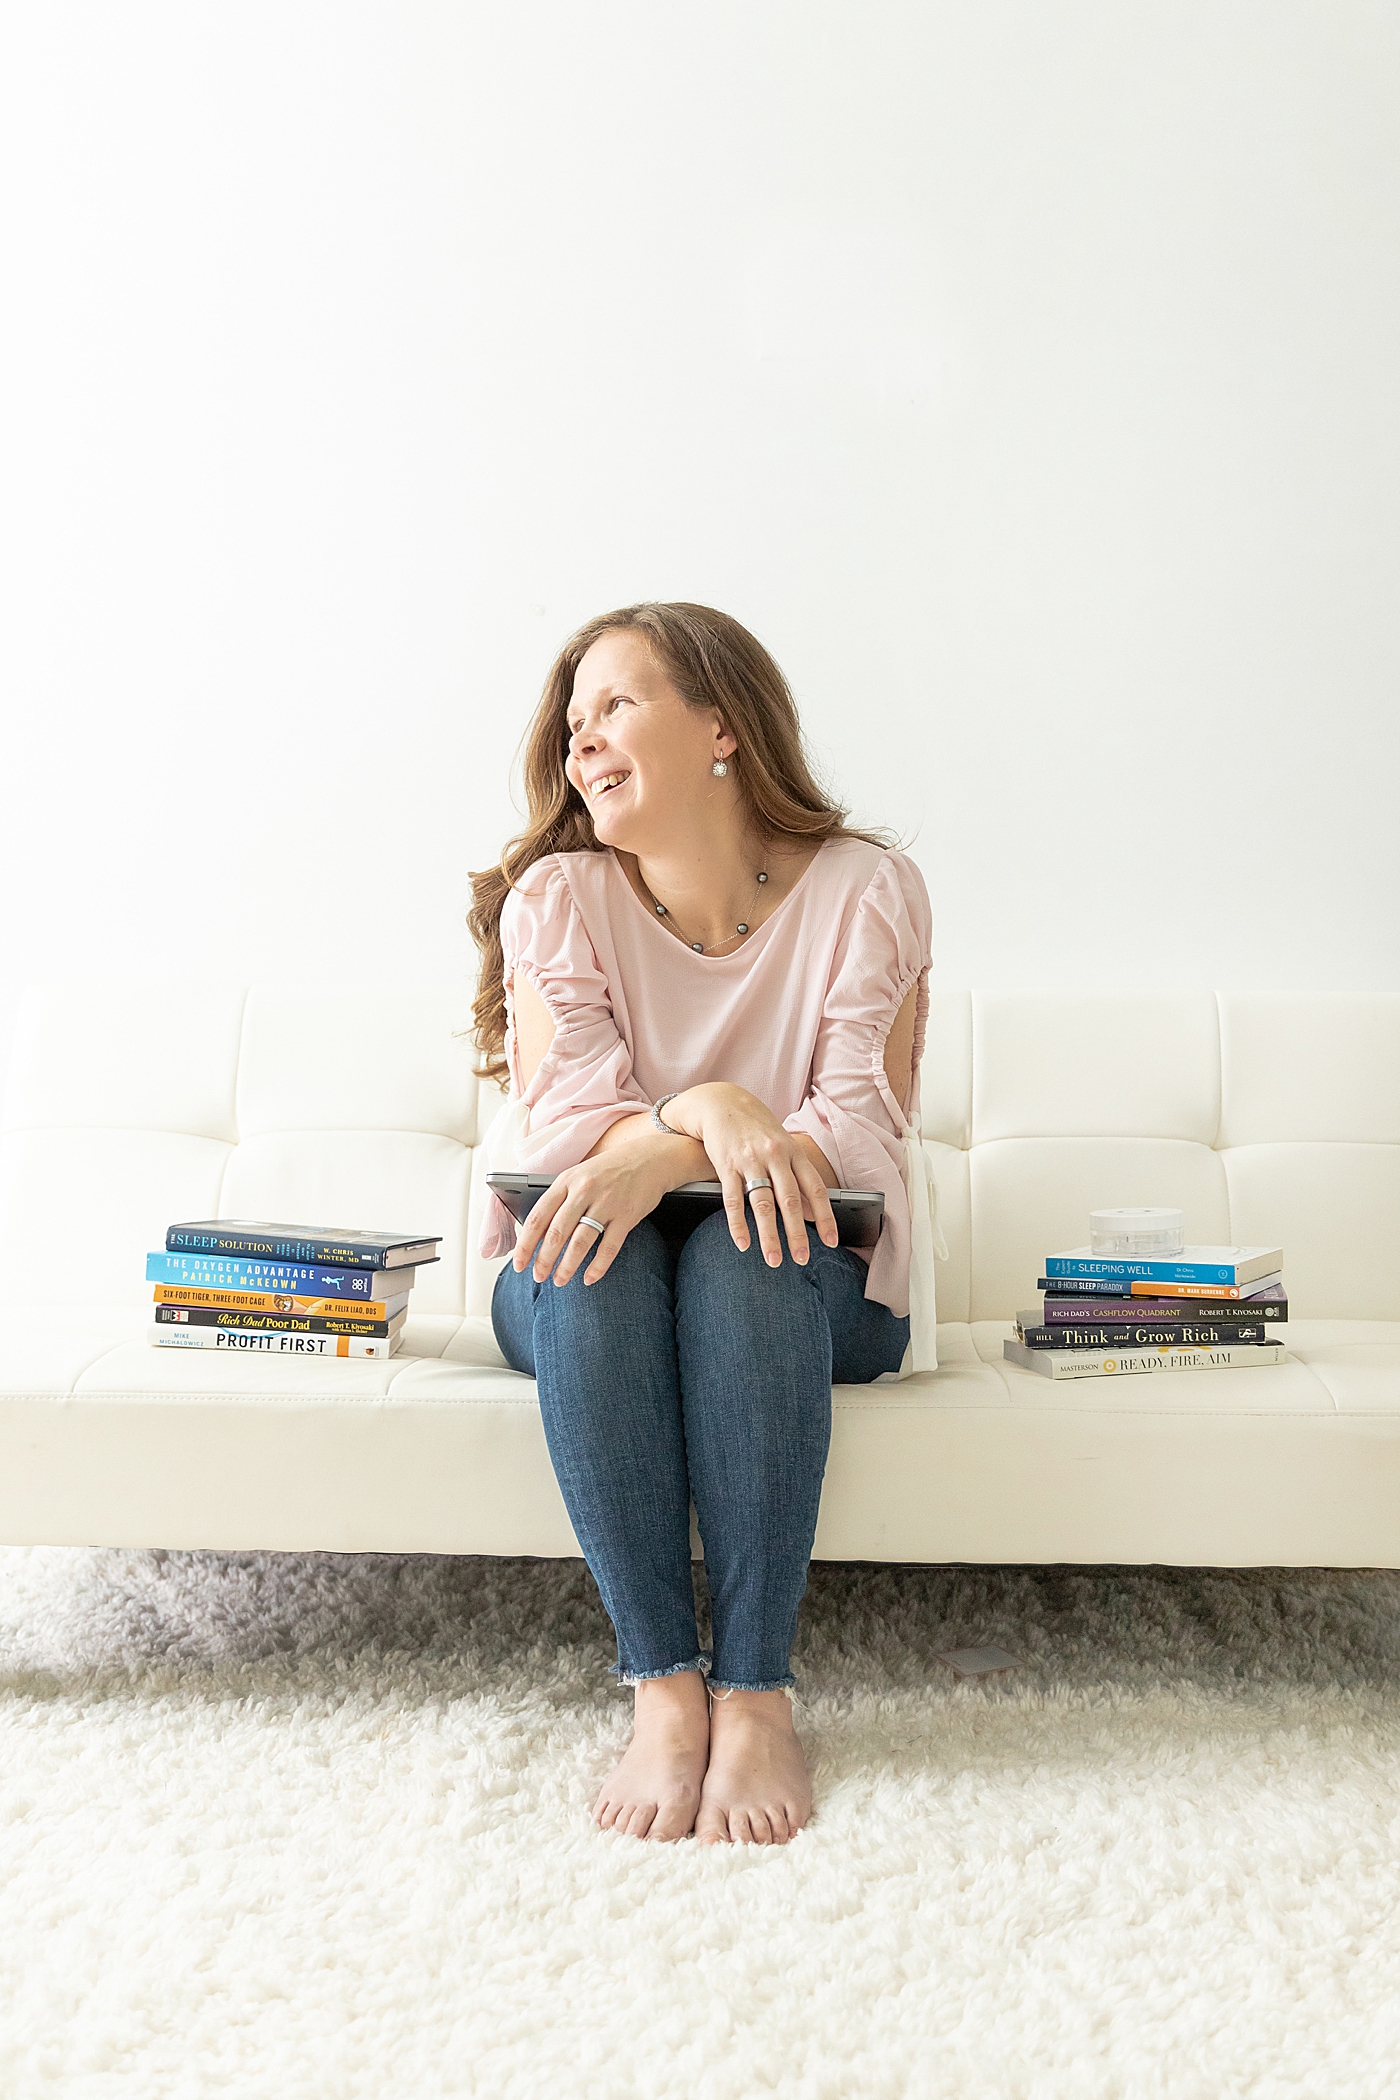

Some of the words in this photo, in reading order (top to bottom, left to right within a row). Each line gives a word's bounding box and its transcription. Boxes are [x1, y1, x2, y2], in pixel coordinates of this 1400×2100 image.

[177, 1234, 218, 1248] SLEEP
[219, 1239, 273, 1253] SOLUTION
[317, 1254, 347, 1262] WINTER,
[332, 1248, 354, 1256] CHRIS
[166, 1258, 187, 1269] THE
[194, 1260, 240, 1273] OXYGEN
[246, 1264, 315, 1279] ADVANTAGE
[1078, 1263, 1125, 1274] SLEEPING
[1127, 1266, 1153, 1275] WELL
[182, 1271, 233, 1284] PATRICK
[240, 1276, 297, 1290] McKEOWN
[1057, 1281, 1078, 1289] 8-HOUR
[1078, 1282, 1096, 1290] SLEEP
[1096, 1283, 1124, 1292] PARADOX
[163, 1290, 192, 1300] SIX-FOOT
[192, 1292, 212, 1302] TIGER,
[212, 1294, 248, 1305] THREE-FOOT
[249, 1297, 266, 1306] CAGE
[324, 1304, 334, 1312] DR.
[334, 1305, 350, 1313] FELIX
[350, 1306, 365, 1315] LIAO,
[365, 1307, 377, 1315] DDS
[1092, 1309, 1136, 1317] CASHFLOW
[1136, 1309, 1181, 1317] QUADRANT
[216, 1313, 240, 1325] Rich
[242, 1316, 266, 1327] Dad
[265, 1317, 288, 1329] Poor
[290, 1319, 311, 1331] Dad
[326, 1321, 344, 1329] Robert
[351, 1323, 375, 1331] Kiyosaki
[159, 1339, 204, 1347] MICHALOWICZ
[216, 1333, 274, 1349] PROFIT
[280, 1337, 327, 1353] FIRST
[1062, 1329, 1109, 1344] Think
[1113, 1333, 1130, 1341] and
[1135, 1328, 1175, 1343] Grow
[1181, 1328, 1220, 1342] Rich
[1060, 1363, 1099, 1373] MASTERSON
[1119, 1356, 1167, 1371] READY,
[1170, 1354, 1204, 1368] FIRE,
[1206, 1352, 1232, 1365] AIM
